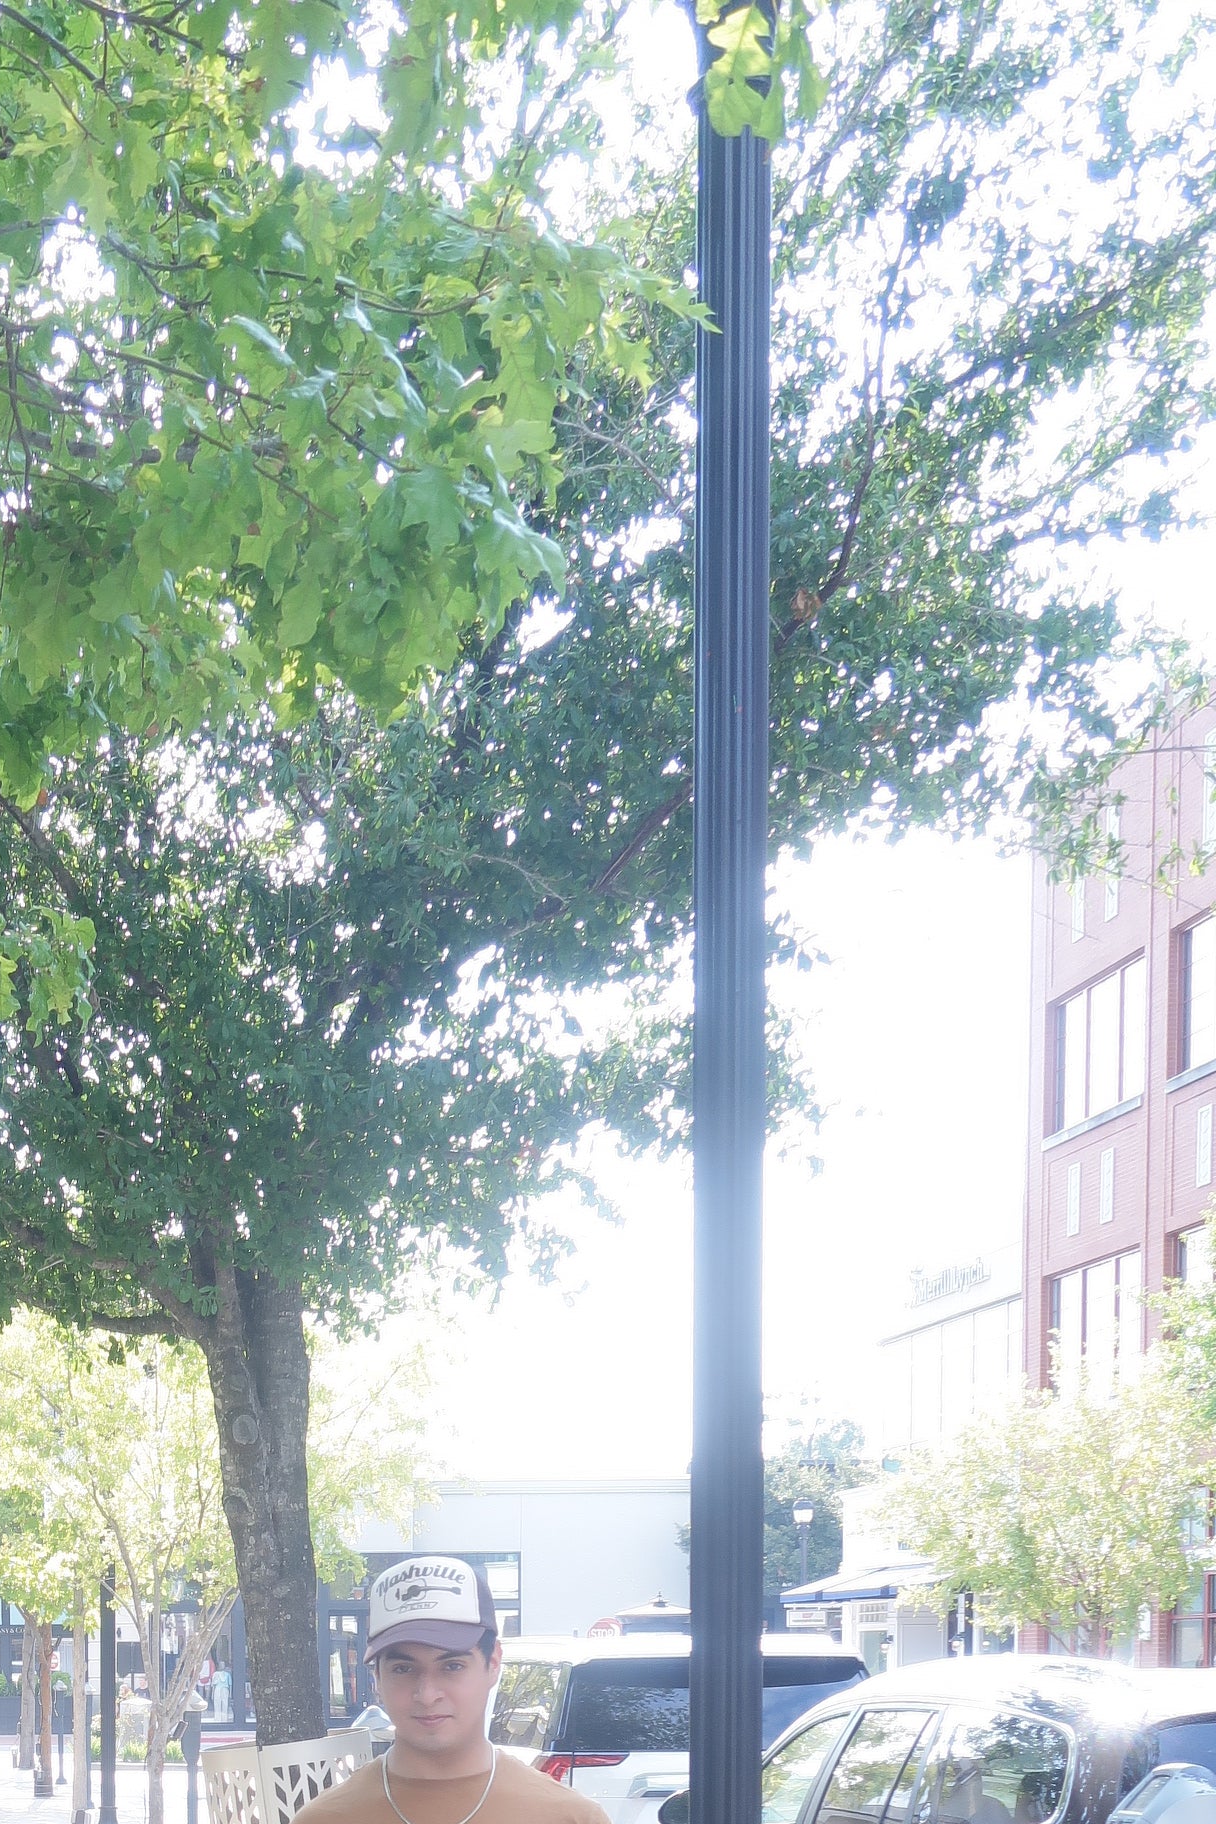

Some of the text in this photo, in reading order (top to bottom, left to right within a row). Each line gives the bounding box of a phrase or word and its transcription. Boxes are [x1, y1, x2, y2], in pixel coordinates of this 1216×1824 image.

[916, 1257, 984, 1304] Merrill Lynch
[376, 1564, 466, 1598] Nashville
[590, 1628, 614, 1638] STOP
